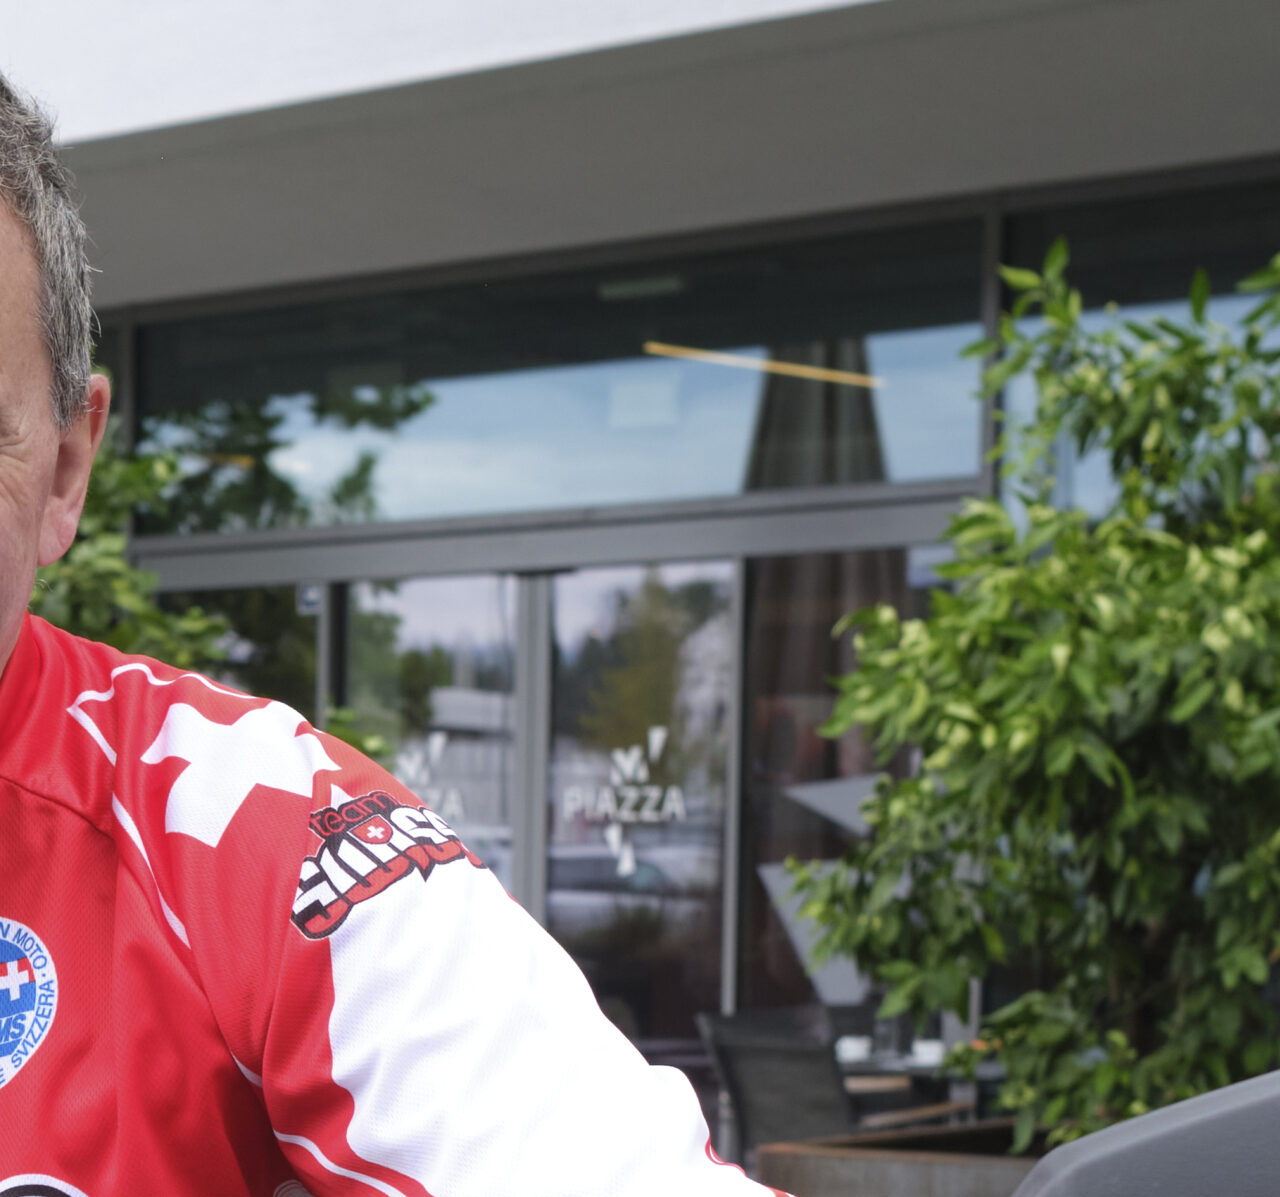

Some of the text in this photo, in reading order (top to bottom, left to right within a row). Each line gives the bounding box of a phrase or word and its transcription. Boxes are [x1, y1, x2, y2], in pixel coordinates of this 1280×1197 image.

[310, 793, 401, 837] team
[563, 785, 686, 821] PIAZZA
[12, 928, 48, 971] MOTO
[11, 979, 56, 1069] SVIZZERA
